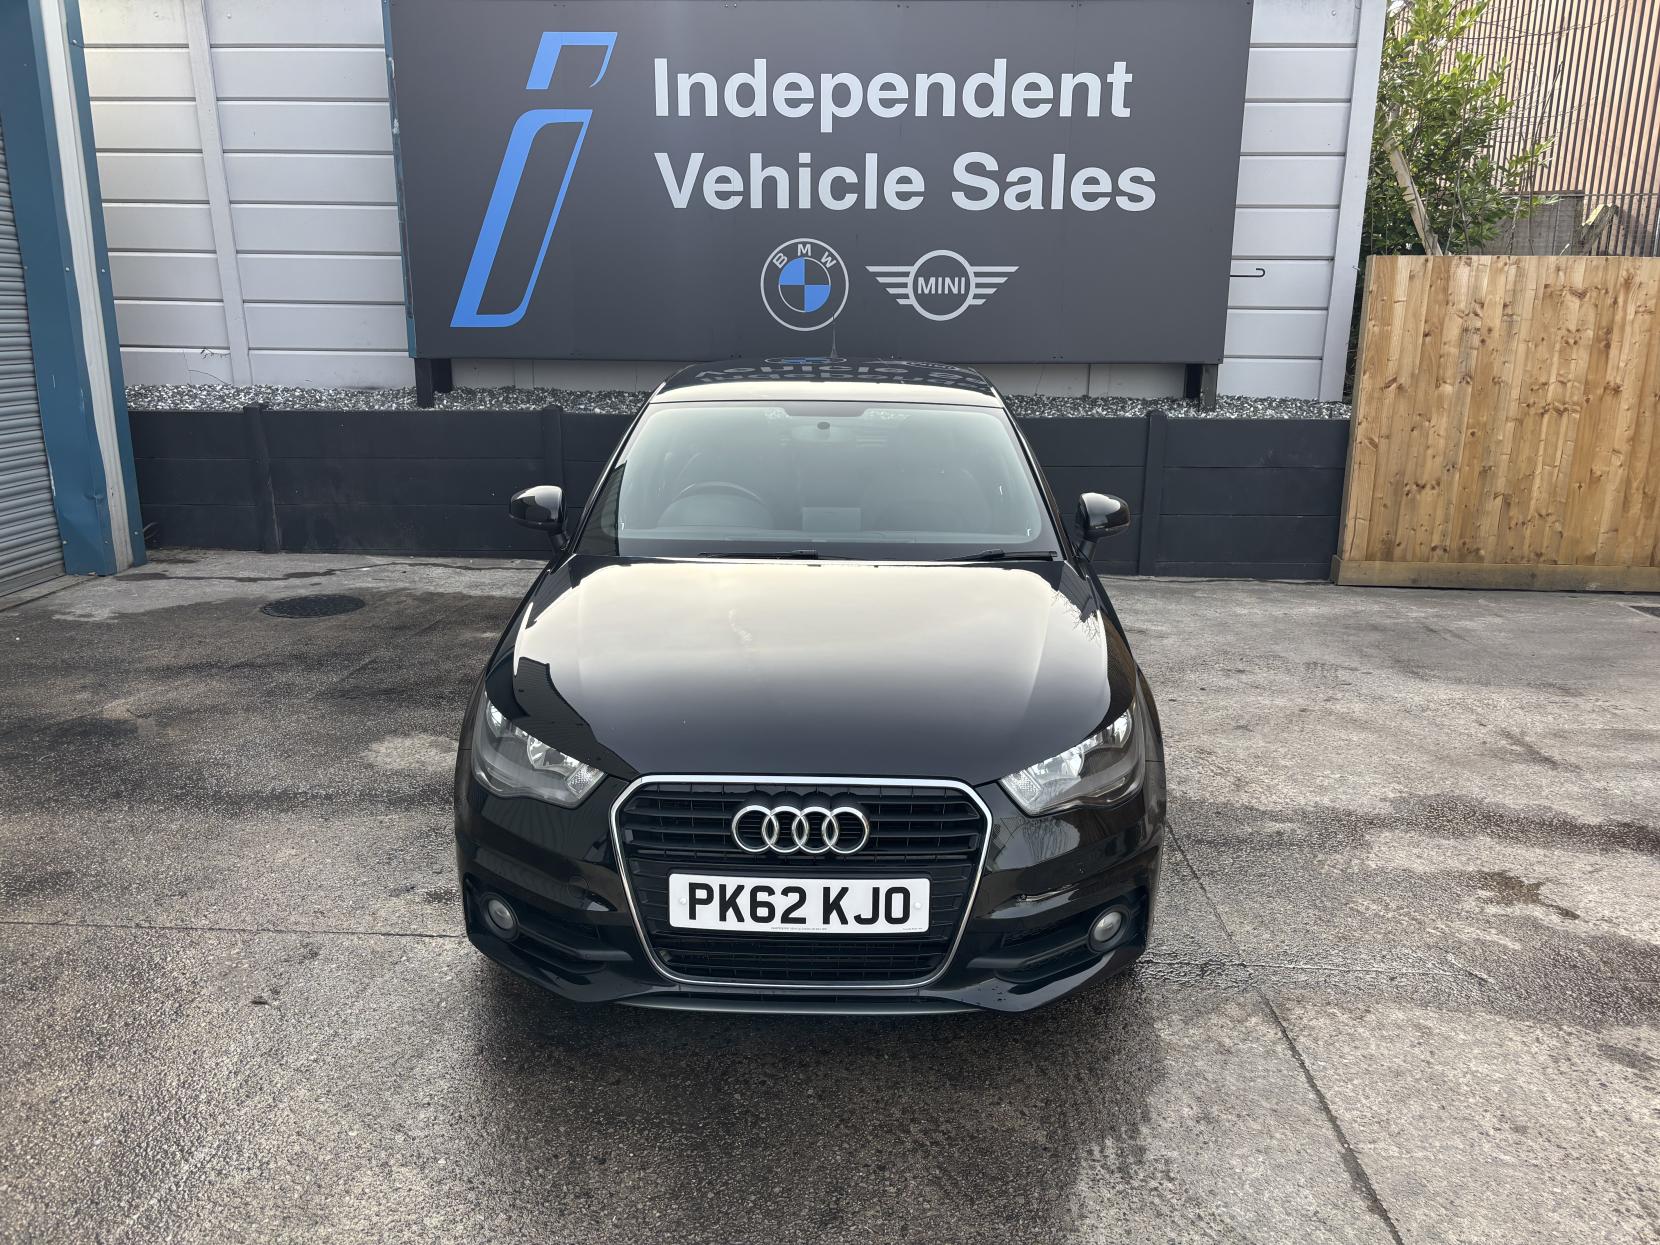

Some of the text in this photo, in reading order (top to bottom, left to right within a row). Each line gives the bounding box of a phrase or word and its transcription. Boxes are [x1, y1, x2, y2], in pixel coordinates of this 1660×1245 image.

[654, 58, 1132, 133] Independent
[654, 151, 1156, 211] Vehicle Sales
[772, 243, 837, 270] BMW
[917, 276, 965, 294] MINI
[688, 882, 911, 925] PK62 KJO
